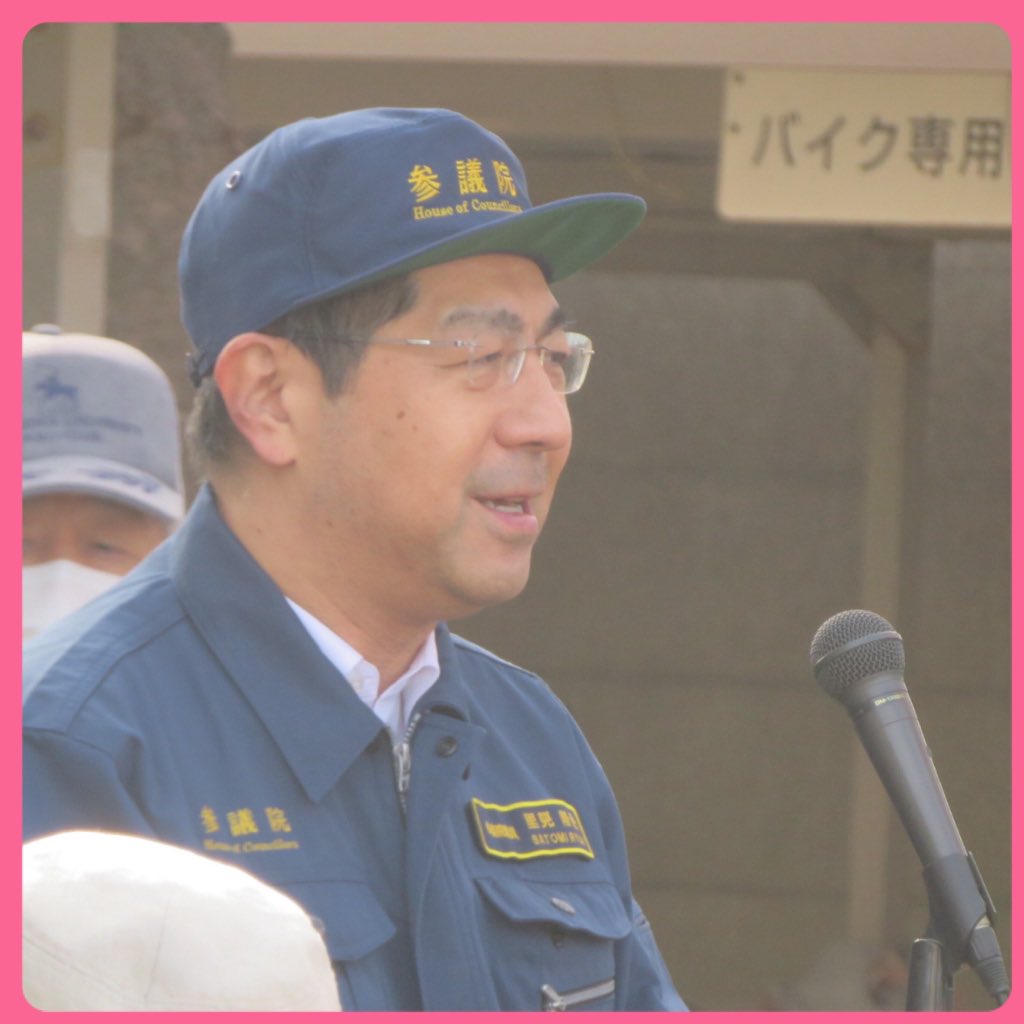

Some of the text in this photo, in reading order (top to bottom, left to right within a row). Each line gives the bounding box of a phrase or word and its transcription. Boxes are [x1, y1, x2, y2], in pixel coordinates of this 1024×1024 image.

[751, 111, 1004, 178] バイク専用
[408, 159, 517, 202] 参議院
[413, 205, 453, 220] House
[456, 201, 469, 214] of
